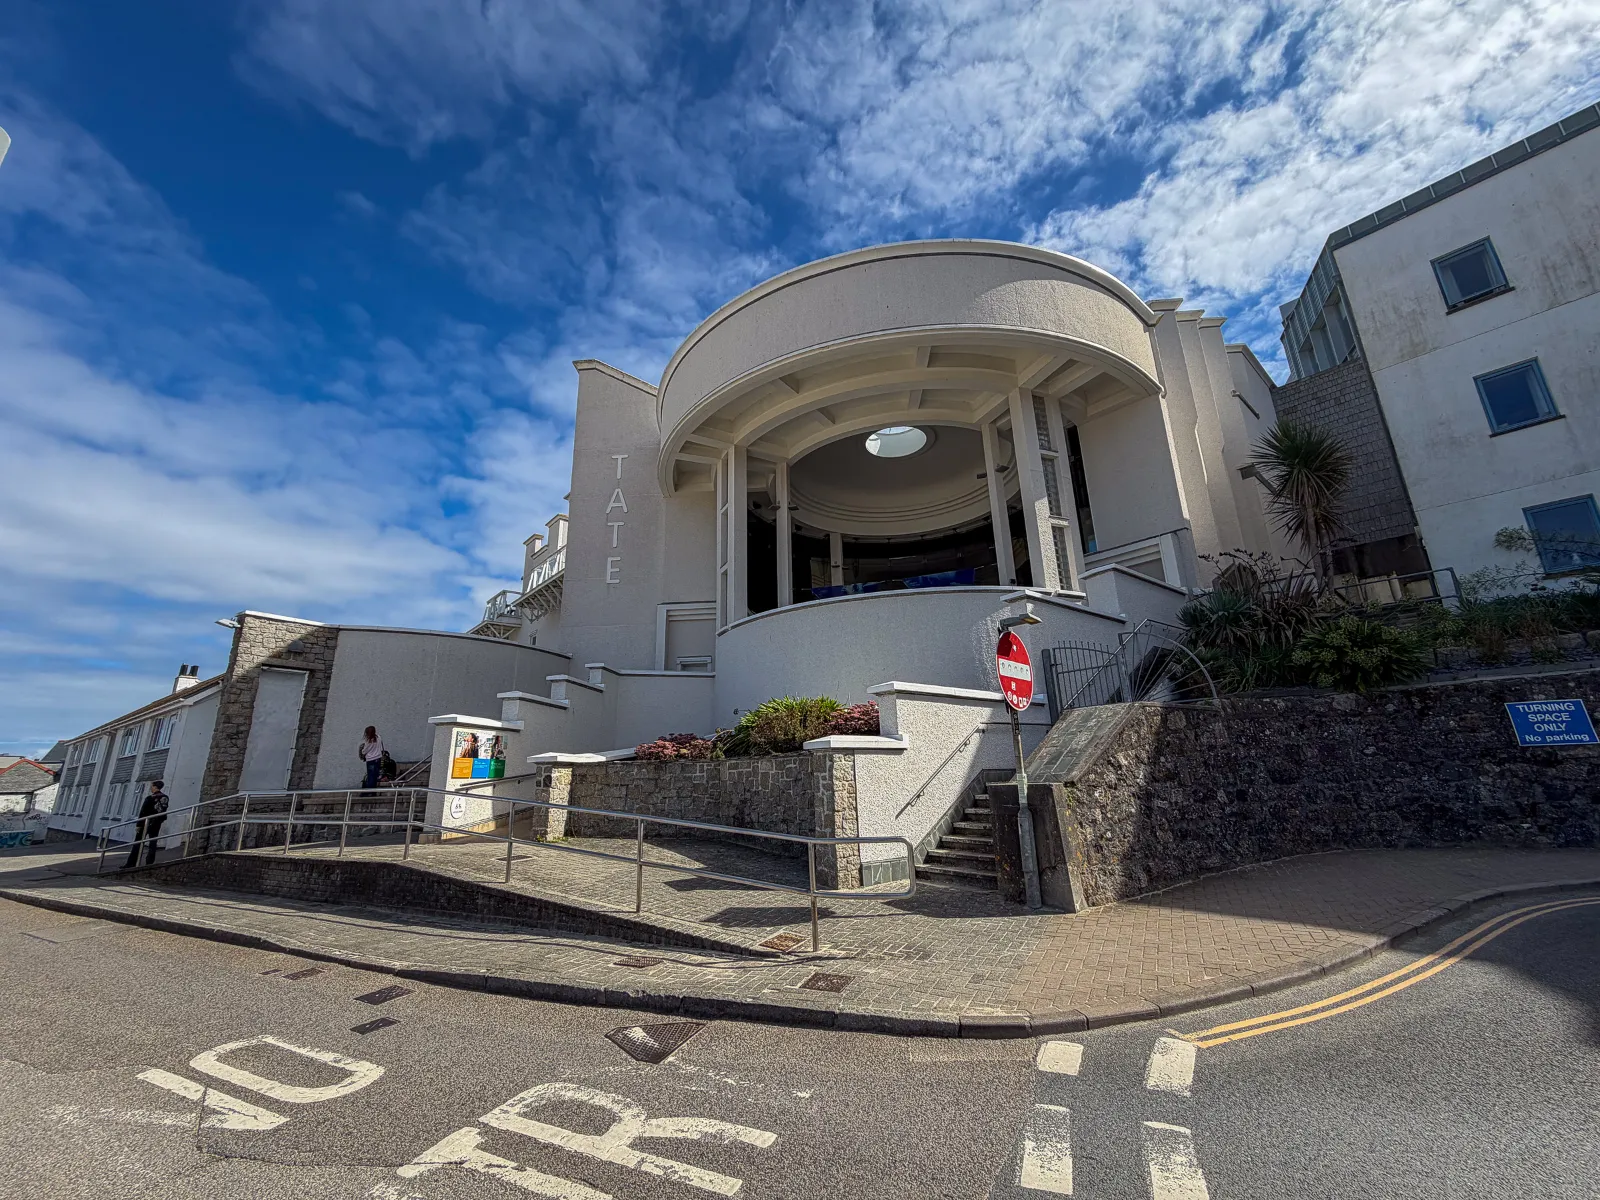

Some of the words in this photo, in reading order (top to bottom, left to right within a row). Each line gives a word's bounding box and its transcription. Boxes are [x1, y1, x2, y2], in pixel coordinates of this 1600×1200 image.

[605, 454, 629, 584] TATE
[1516, 703, 1575, 712] TURNING
[1528, 712, 1571, 722] SPACE
[1534, 722, 1566, 732] ONLY
[1525, 734, 1541, 742] No
[1545, 733, 1589, 742] parking
